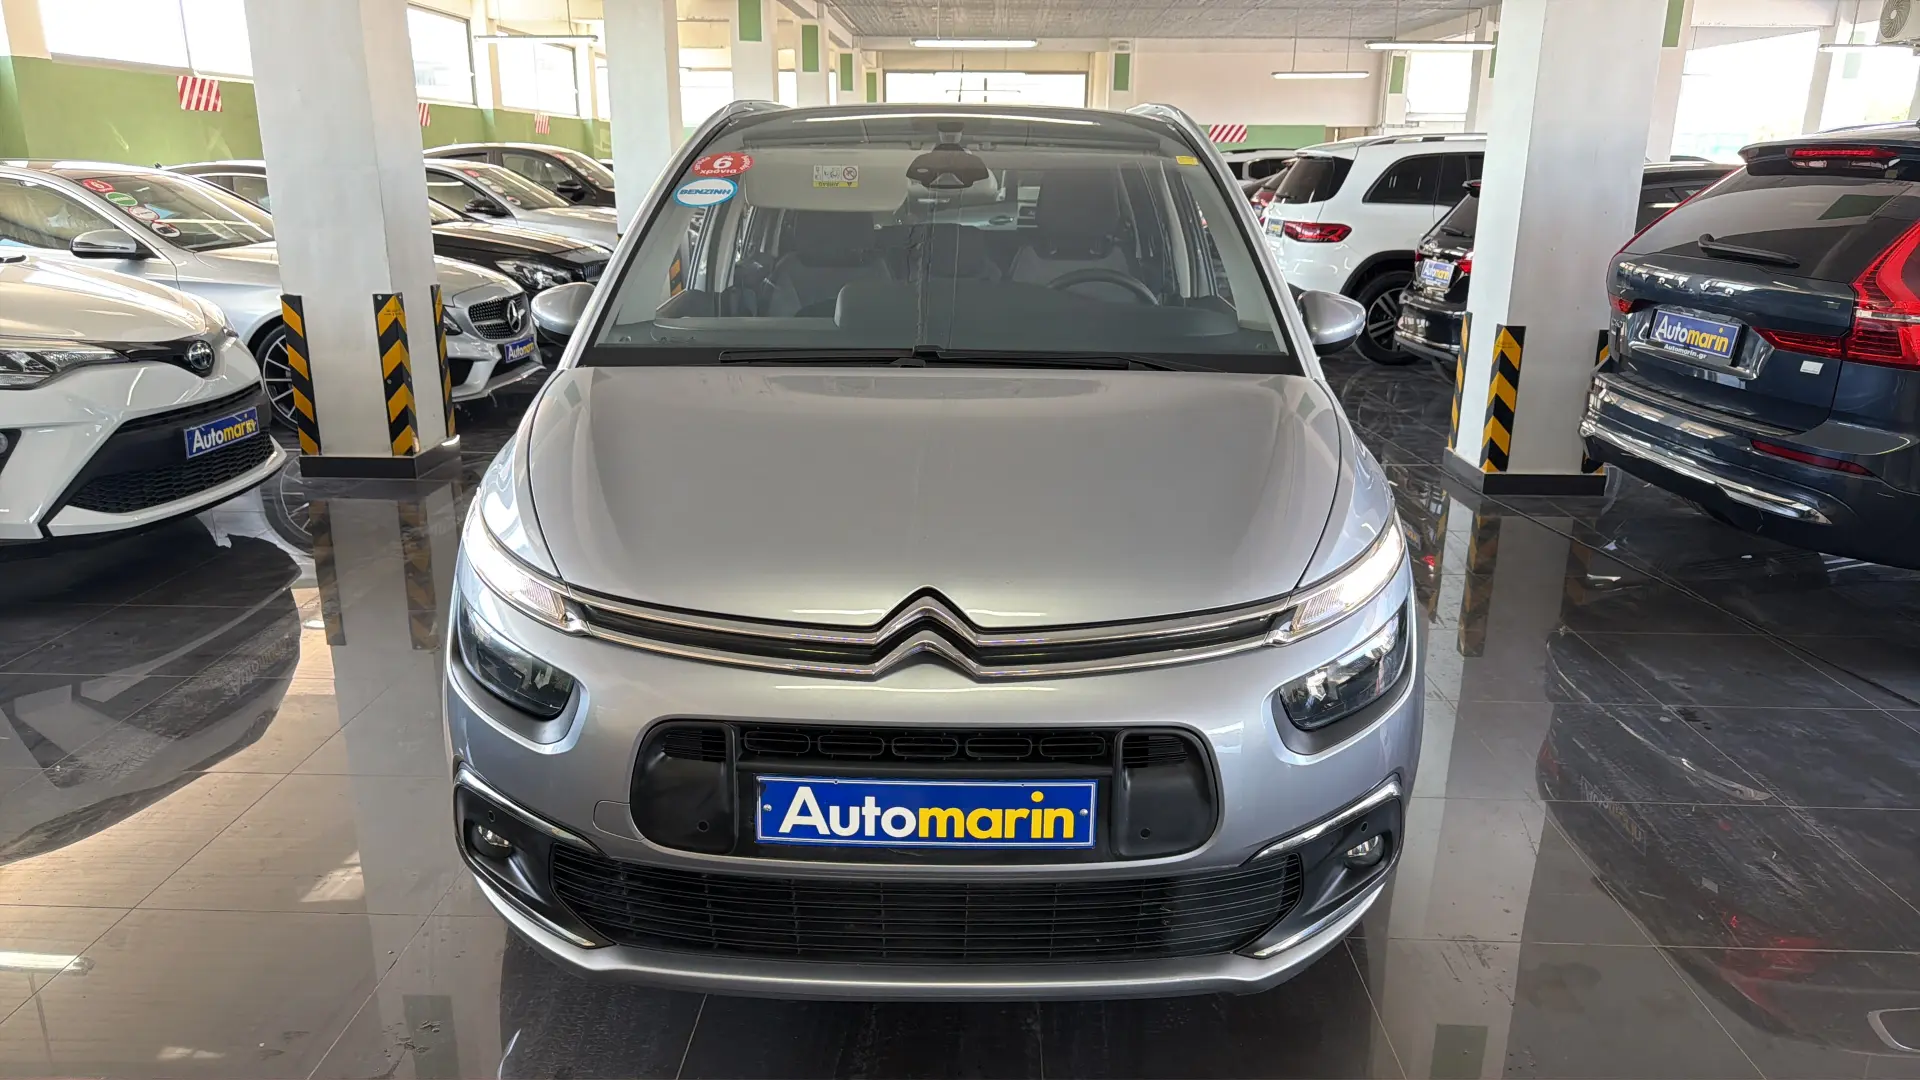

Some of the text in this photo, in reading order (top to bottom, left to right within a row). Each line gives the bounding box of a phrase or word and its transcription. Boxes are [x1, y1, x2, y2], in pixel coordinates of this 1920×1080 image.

[712, 157, 734, 169] 6
[1657, 315, 1730, 353] Automarin
[777, 786, 1076, 840] Automarin
